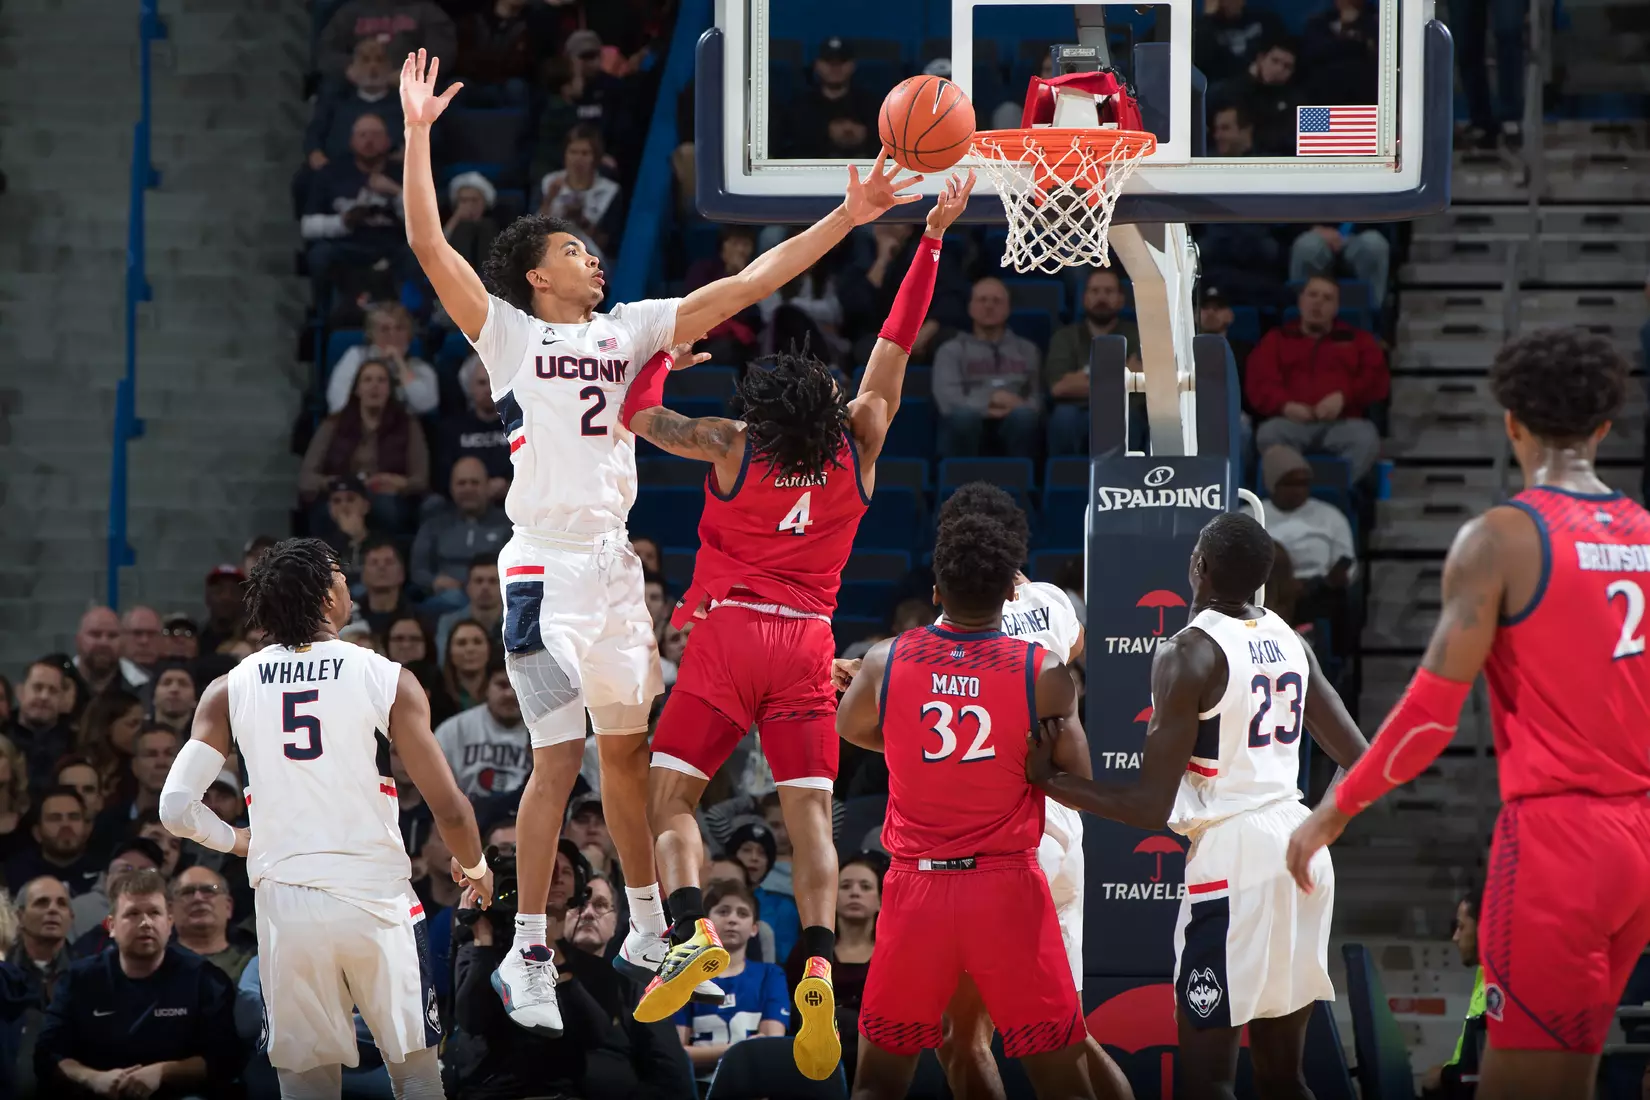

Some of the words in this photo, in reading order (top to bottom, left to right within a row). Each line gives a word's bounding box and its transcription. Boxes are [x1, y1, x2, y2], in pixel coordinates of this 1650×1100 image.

[535, 355, 629, 384] UCONN
[579, 386, 608, 437] 2
[776, 491, 813, 536] 4
[1098, 484, 1220, 512] SPALDING
[1606, 579, 1646, 662] 2
[258, 658, 344, 684] WHALEY
[931, 672, 980, 698] MAYO
[282, 689, 324, 761] 5
[920, 700, 996, 763] 32
[1248, 671, 1302, 748] 23
[154, 1008, 187, 1017] UCONN
